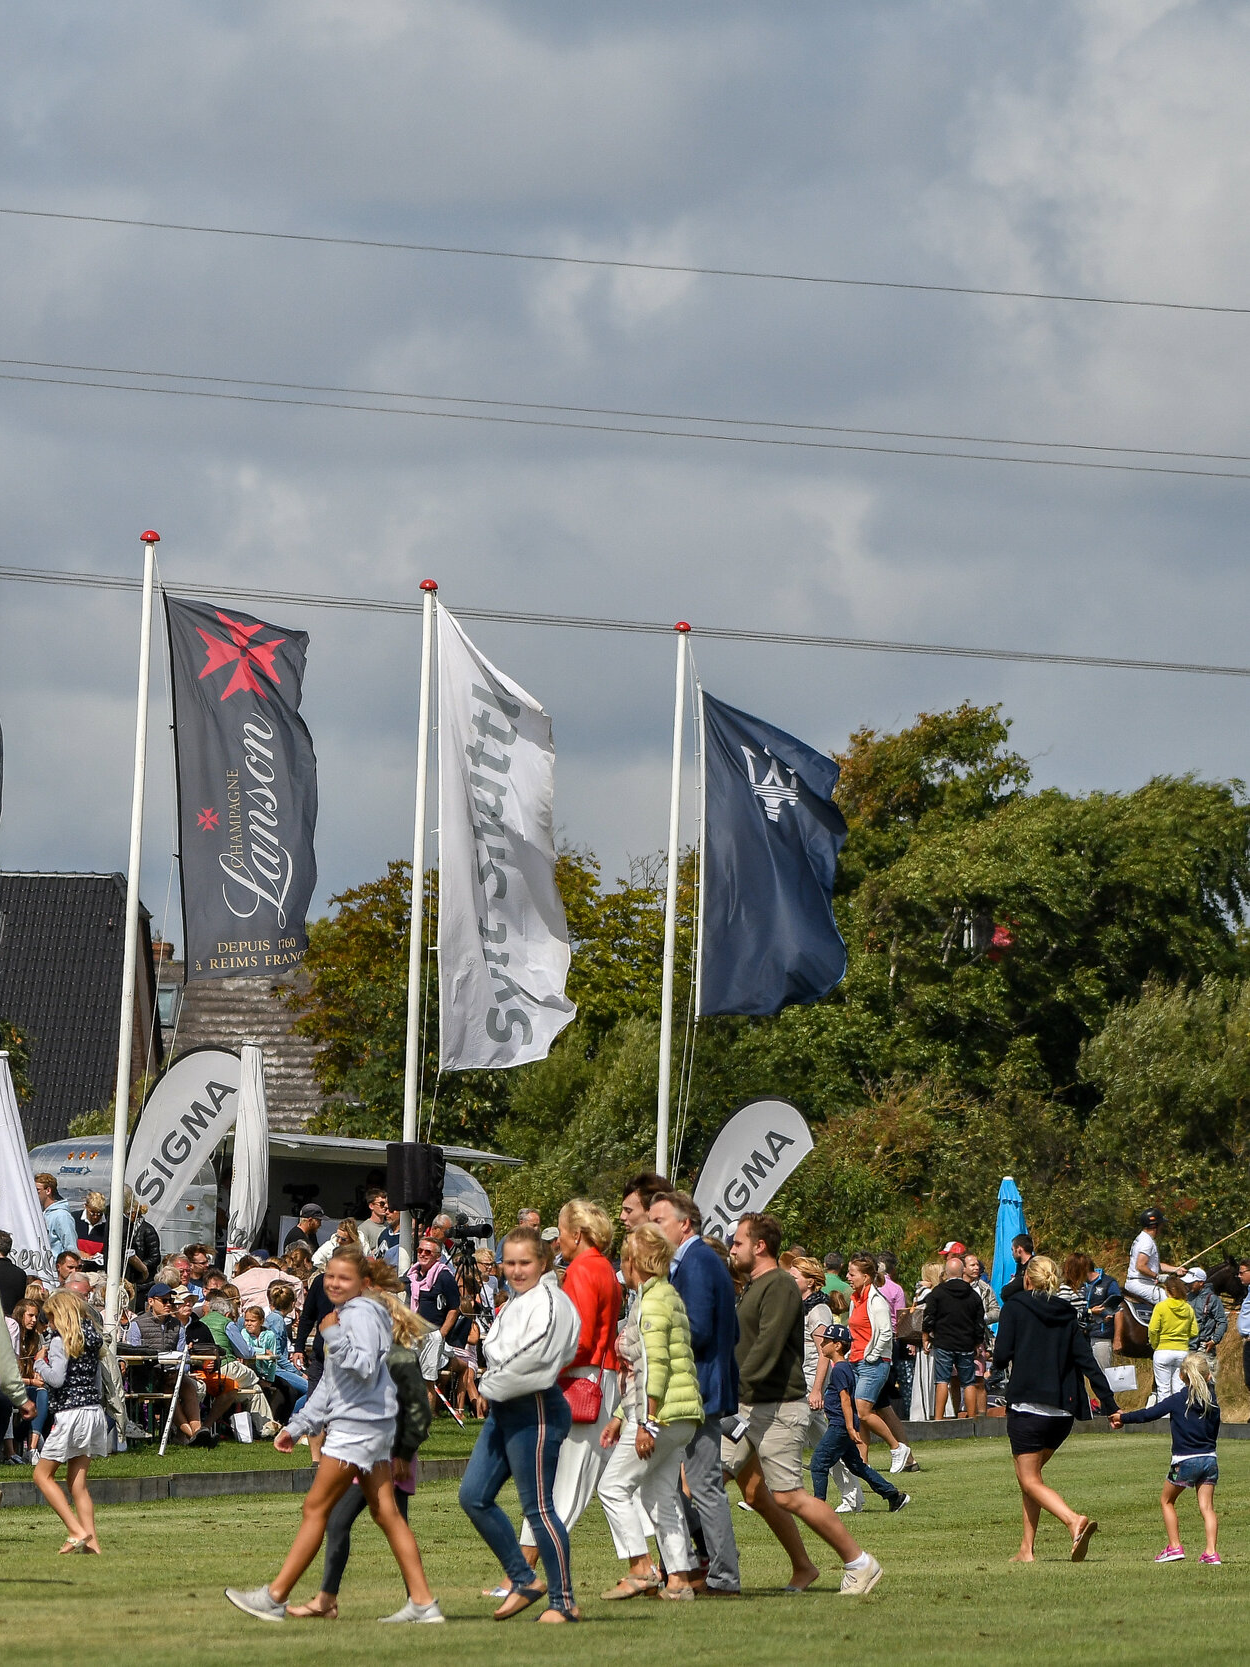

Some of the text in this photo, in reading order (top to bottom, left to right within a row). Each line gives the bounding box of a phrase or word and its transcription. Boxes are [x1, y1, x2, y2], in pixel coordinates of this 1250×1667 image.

[218, 711, 293, 930] Lanson
[226, 767, 244, 870] CHAMPAGNE
[209, 956, 258, 970] REIMS
[265, 949, 308, 967] FRANC
[217, 937, 296, 954] DEPUIS 1760
[134, 1080, 239, 1207] SIGMA
[701, 1130, 796, 1241] SIGMA
